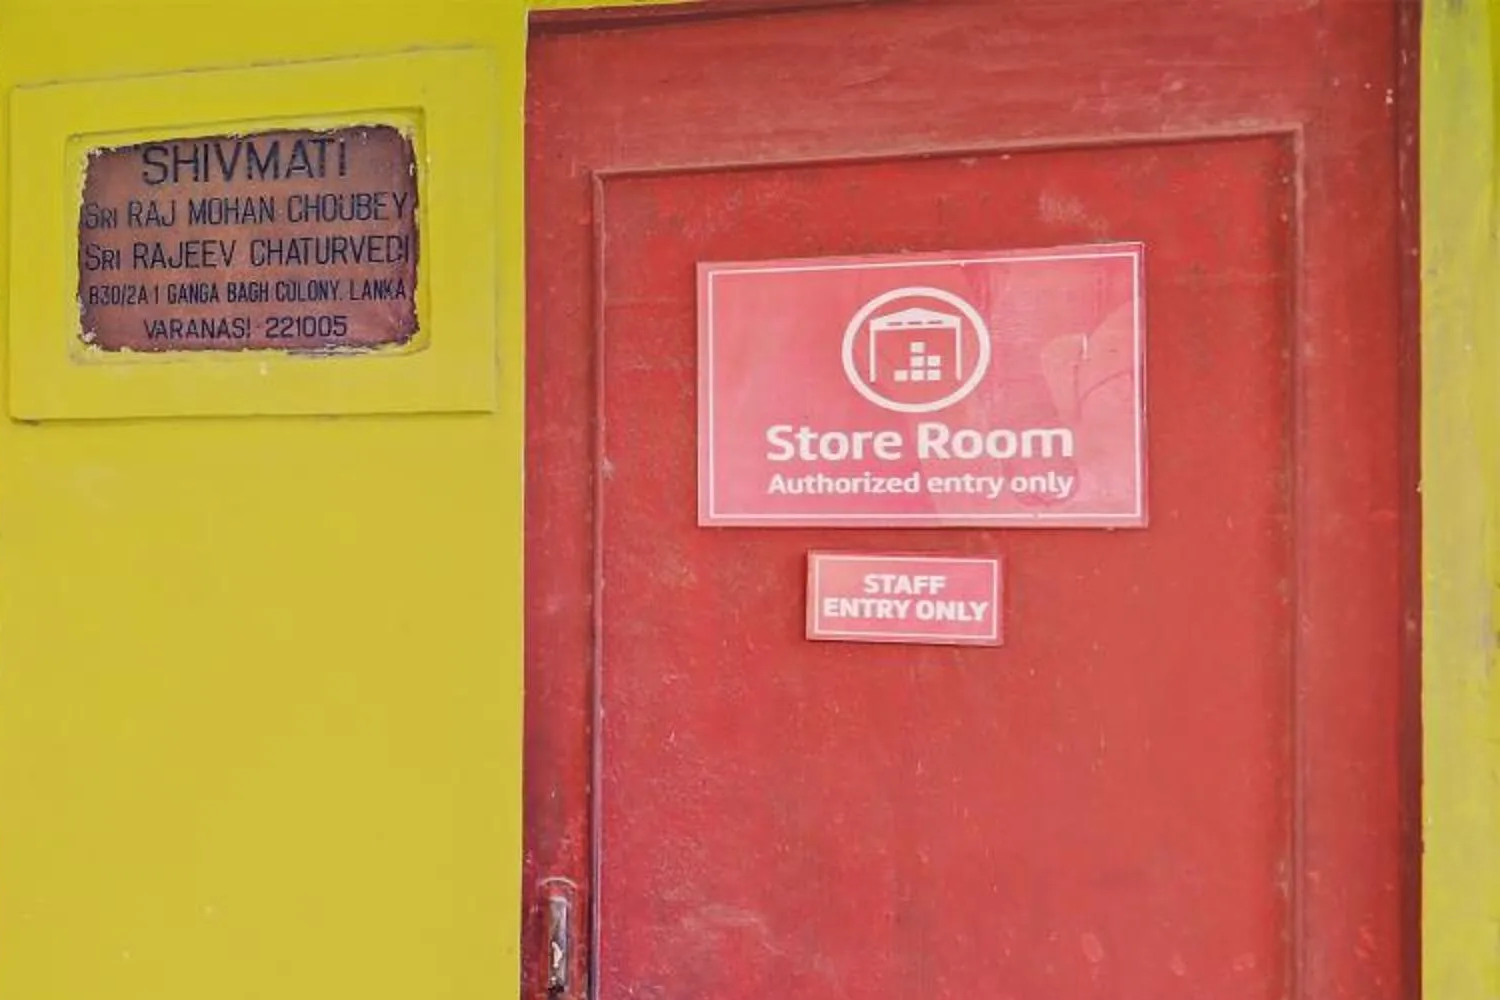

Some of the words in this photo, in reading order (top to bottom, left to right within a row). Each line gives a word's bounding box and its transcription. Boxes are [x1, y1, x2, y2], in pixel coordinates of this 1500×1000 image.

[142, 137, 348, 185] SHIVMATI
[128, 200, 176, 227] RAJ
[188, 195, 275, 225] MOHAN
[286, 192, 408, 223] CHOUBEY
[133, 239, 237, 269] RAJEEV
[249, 234, 409, 267] CHATURVEDI
[167, 282, 220, 305] GANGA
[227, 281, 269, 303] BAGH
[349, 278, 406, 301] LANKA
[143, 318, 251, 340] VARANASI
[265, 315, 348, 339] 221005
[765, 424, 904, 462] Store
[916, 422, 1074, 460] Room
[766, 472, 921, 496] Authorized
[926, 472, 1005, 499] entry
[1009, 471, 1074, 498] only
[863, 573, 947, 596] STAFF
[823, 597, 909, 622] ENTRY
[915, 598, 990, 622] ONLY
